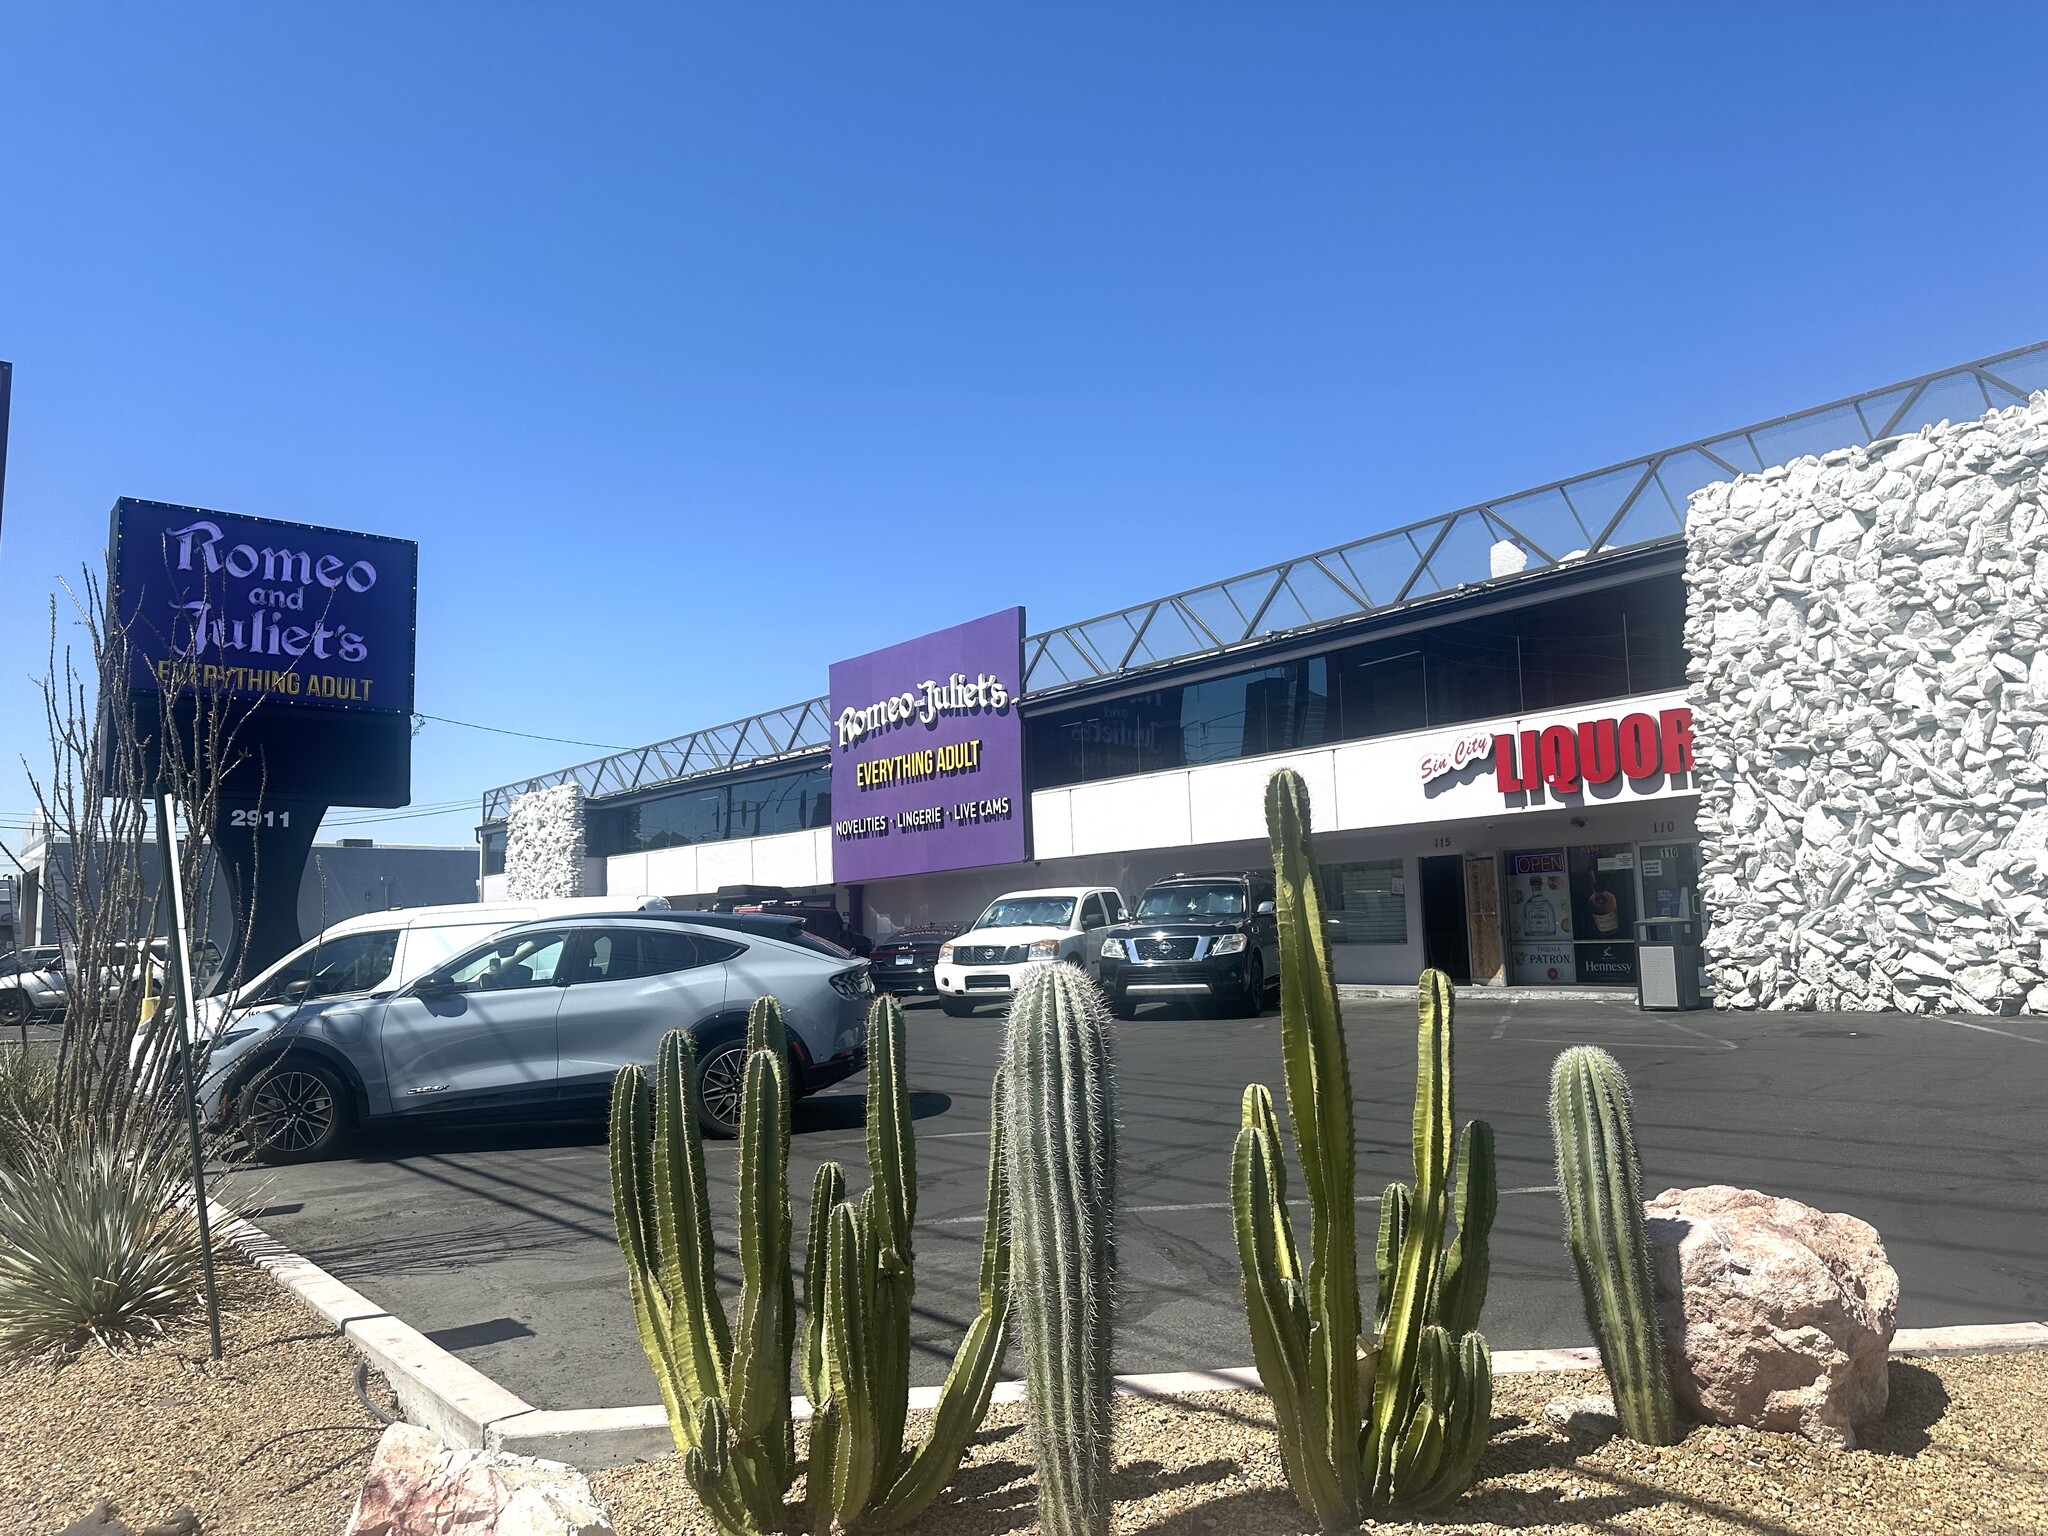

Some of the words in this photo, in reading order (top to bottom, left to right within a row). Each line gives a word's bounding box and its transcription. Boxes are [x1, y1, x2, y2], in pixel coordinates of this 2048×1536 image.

[166, 520, 378, 593] Romeo
[248, 586, 304, 611] and
[168, 600, 369, 663] Juliet's
[157, 660, 301, 696] EVERYTHING
[306, 676, 374, 701] ADULT
[834, 692, 915, 747] Romeo
[917, 672, 1008, 724] Juliet's
[856, 749, 933, 787] EVERYTHING
[936, 739, 980, 772] ADULT
[1420, 755, 1449, 780] Sin
[1454, 734, 1488, 765] City
[1494, 708, 1695, 793] LIQUOR
[230, 809, 290, 828] 2911
[836, 815, 886, 836] NOVELITIES
[897, 806, 942, 828] LINGERIE
[954, 801, 977, 820] LIVE
[979, 797, 1009, 816] CAMS
[1653, 820, 1675, 833] 110
[1434, 836, 1451, 848] 115
[1661, 847, 1677, 858] 110
[1519, 855, 1563, 873] OPEN
[1585, 961, 1633, 975] Hennessy
